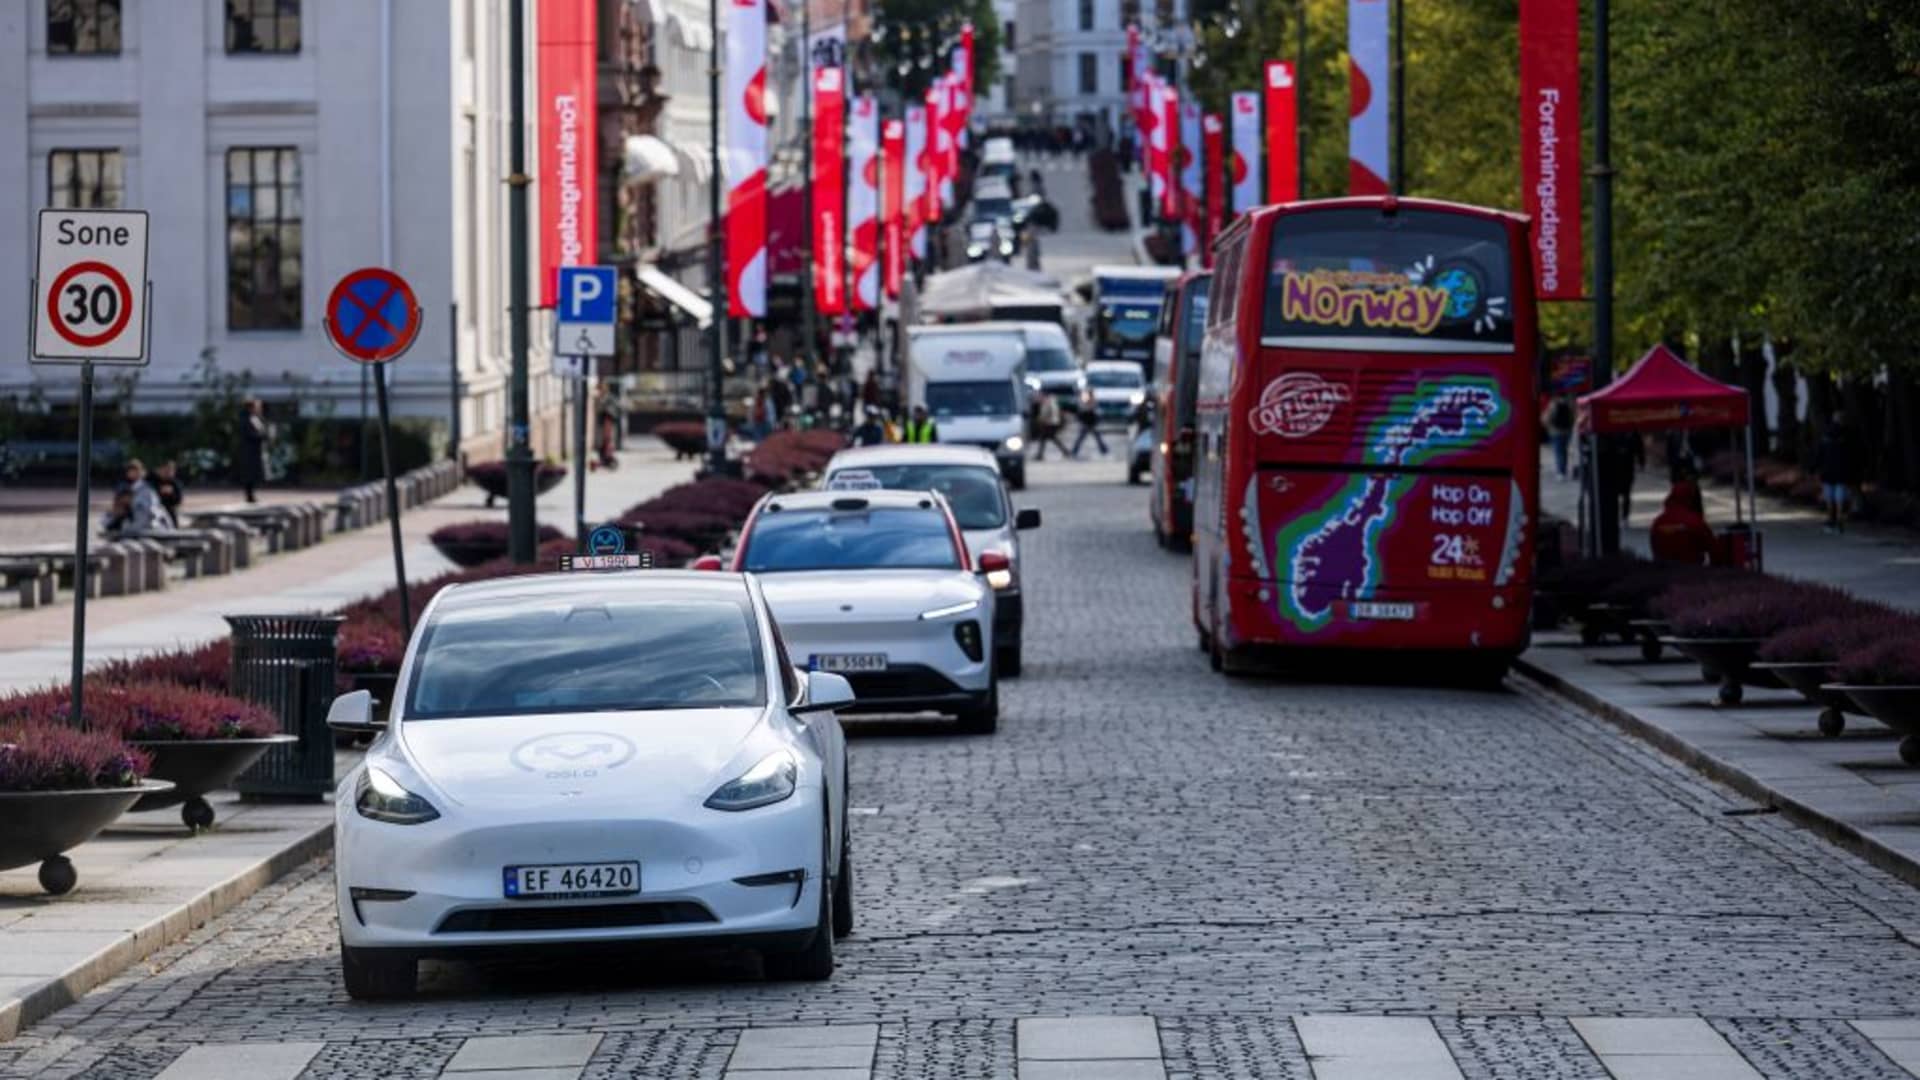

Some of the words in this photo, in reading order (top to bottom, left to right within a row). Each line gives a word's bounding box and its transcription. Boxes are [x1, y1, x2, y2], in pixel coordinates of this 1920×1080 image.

[1537, 88, 1560, 291] Forskningsdagene
[57, 218, 130, 246] Sone
[64, 283, 118, 326] 30
[571, 273, 603, 317] P
[1284, 272, 1448, 334] Norway
[1260, 384, 1346, 426] OFFICIAL
[1432, 484, 1464, 503] Hop
[1468, 484, 1491, 502] On
[1432, 506, 1464, 525] Hop
[1467, 506, 1494, 525] Off
[1431, 534, 1462, 564] 24
[524, 869, 550, 891] EF
[560, 866, 632, 890] 46420
